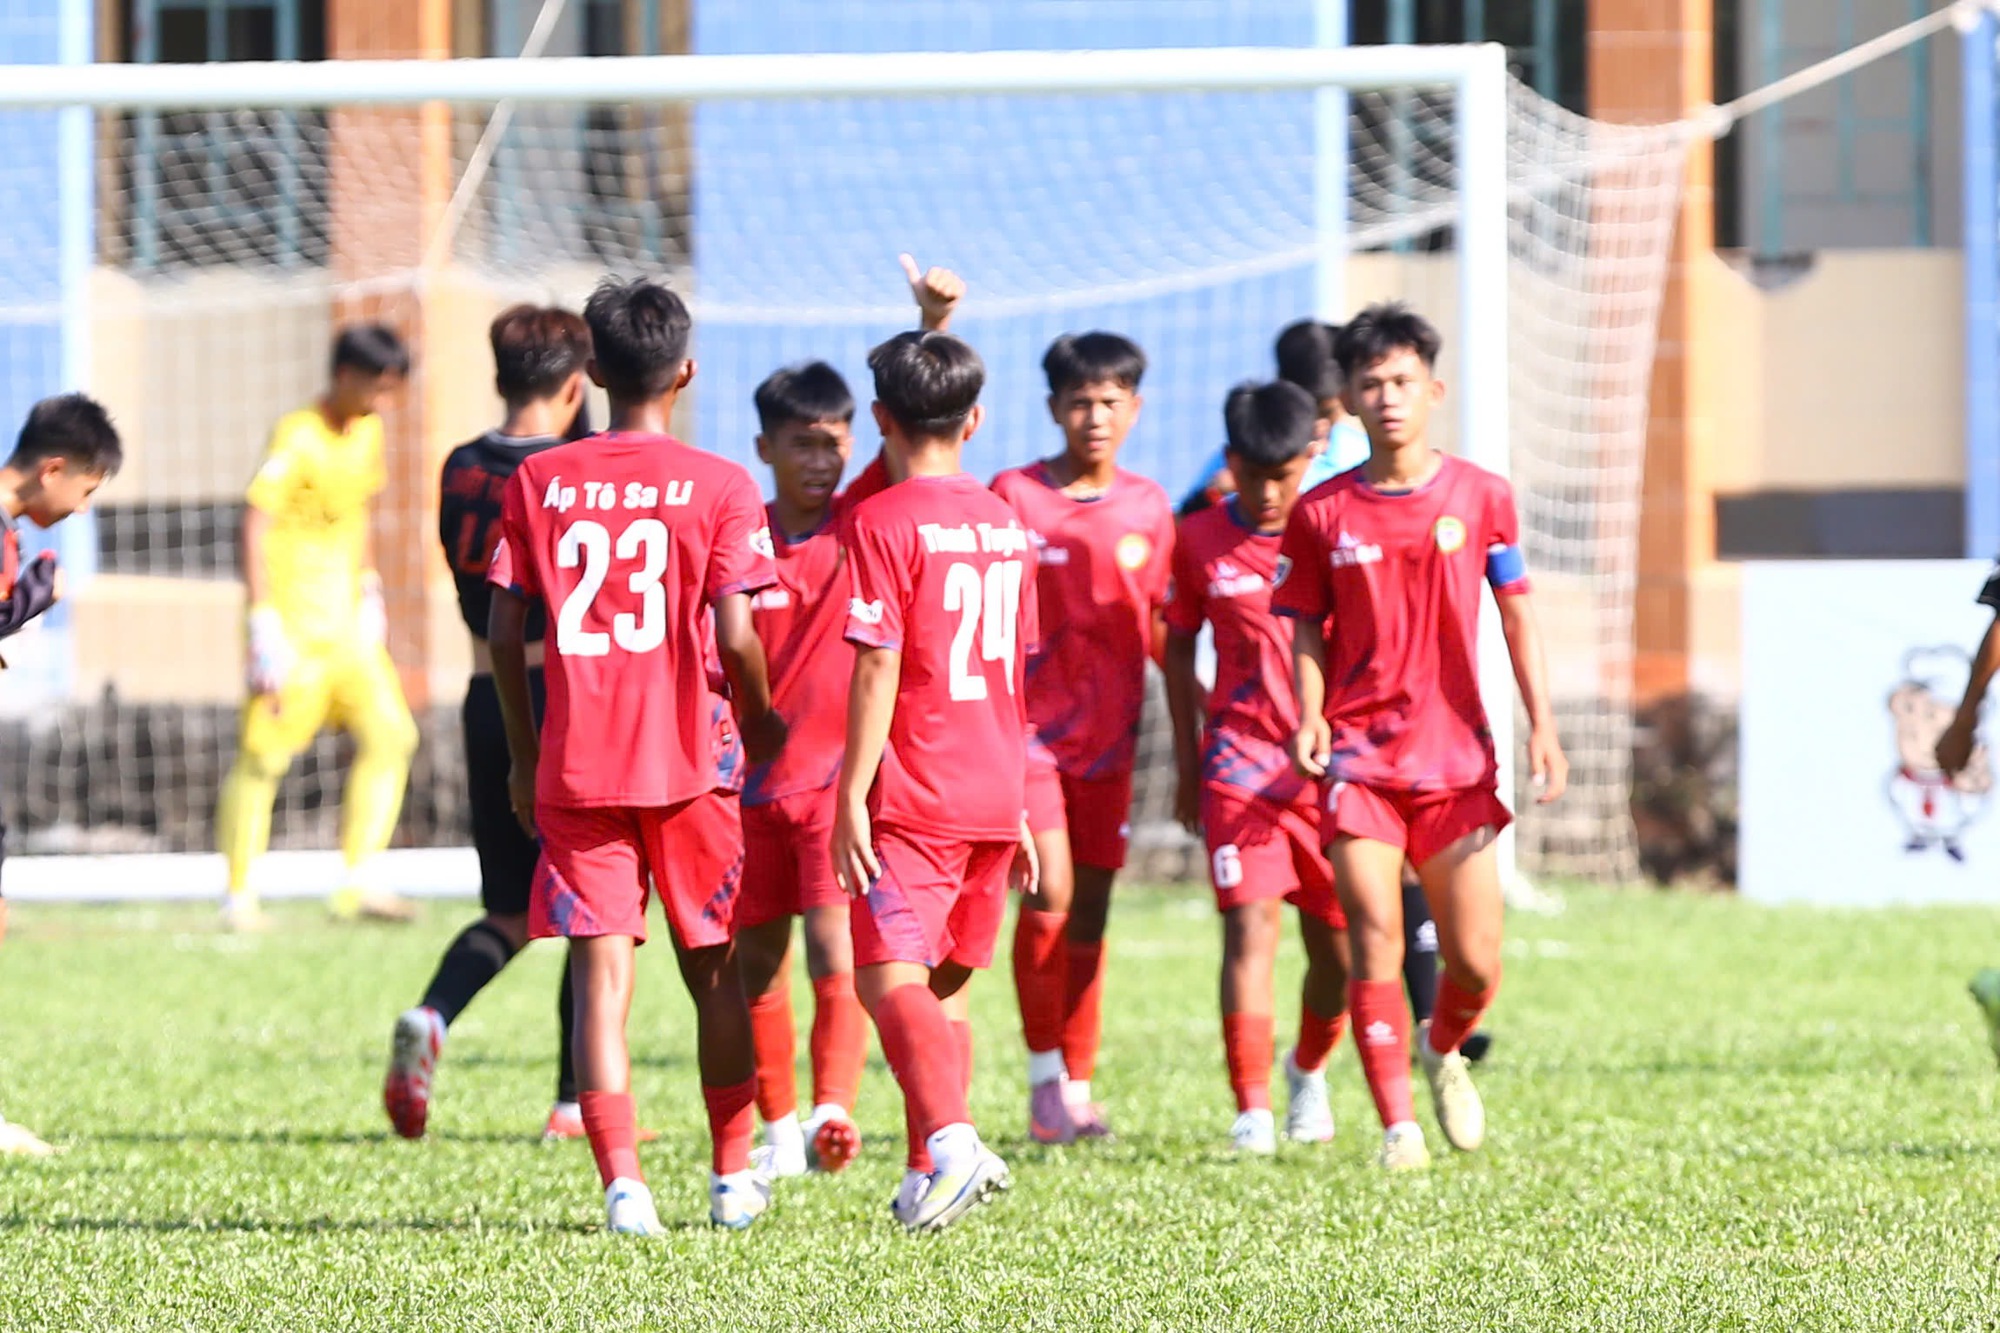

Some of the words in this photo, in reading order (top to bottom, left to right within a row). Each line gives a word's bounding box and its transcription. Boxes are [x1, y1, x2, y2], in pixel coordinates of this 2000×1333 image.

[543, 476, 576, 513] Áp
[584, 481, 616, 510] Tô
[623, 482, 658, 508] Sa
[557, 518, 669, 657] 23
[943, 560, 1023, 701] 24
[1213, 843, 1244, 889] 6
